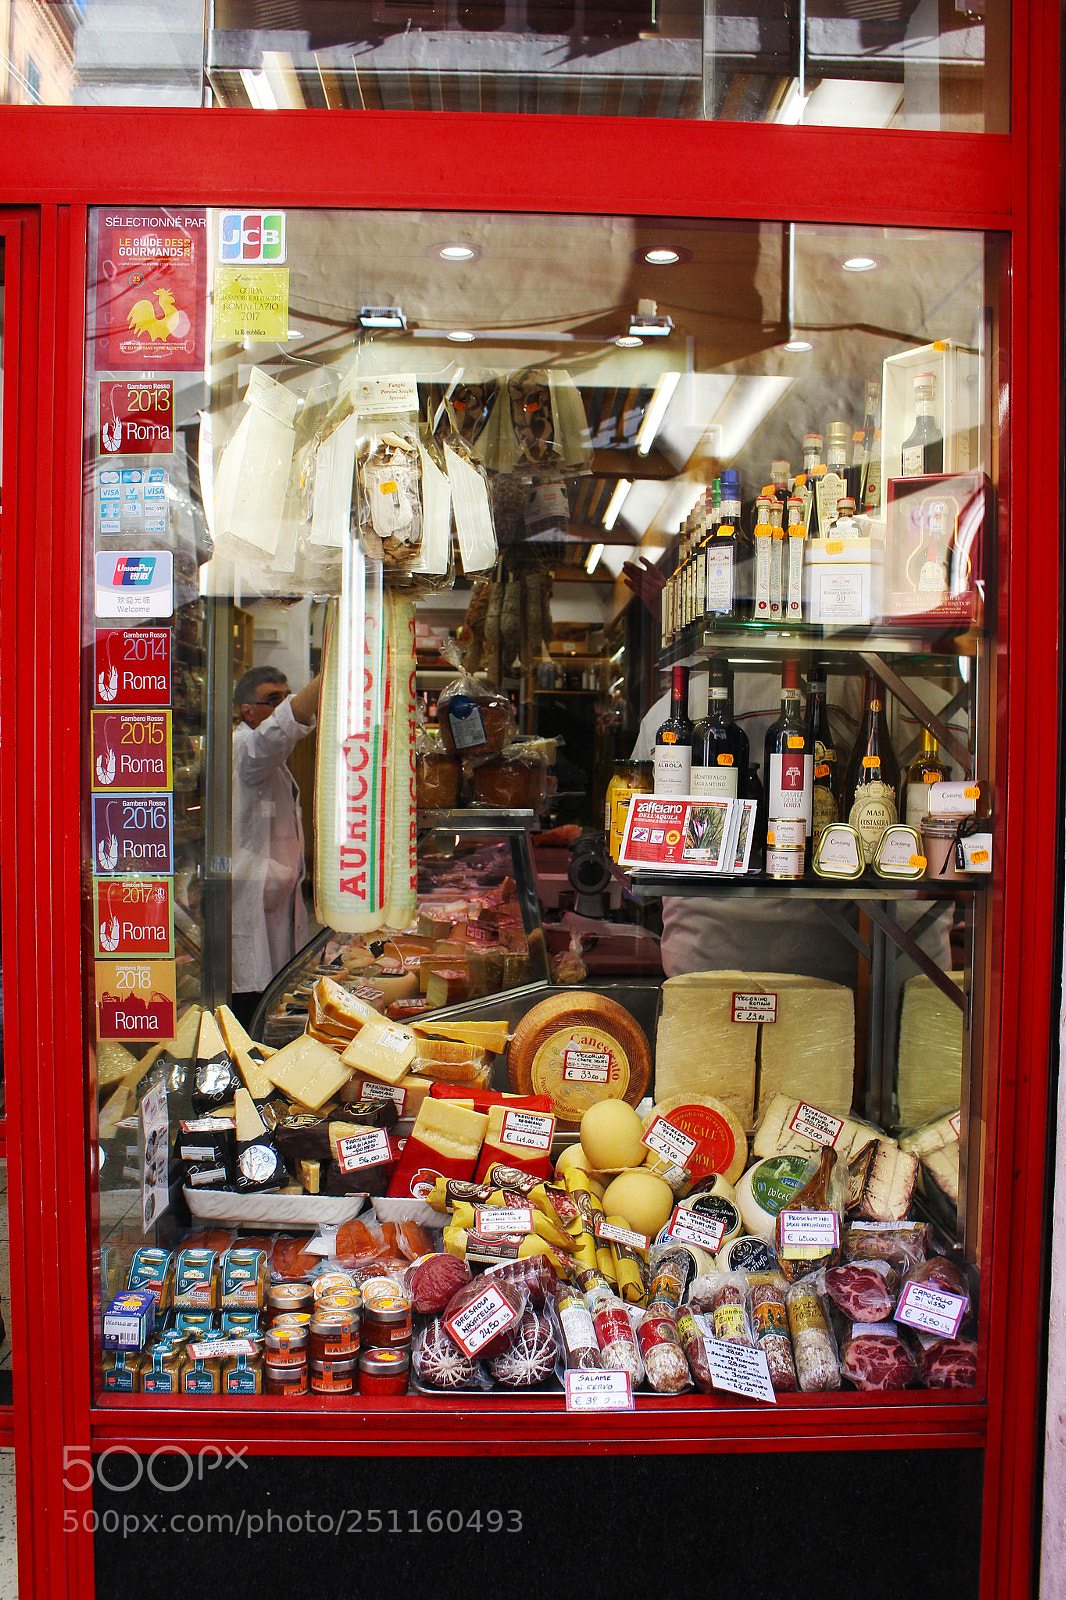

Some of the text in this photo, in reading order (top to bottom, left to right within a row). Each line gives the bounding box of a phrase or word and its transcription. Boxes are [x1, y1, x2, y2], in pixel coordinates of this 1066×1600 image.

[105, 215, 206, 228] SÉLECTIONNÉ PAR
[119, 238, 183, 247] LE GUIDE DES
[222, 228, 281, 245] JCB
[119, 247, 184, 257] GOURMANDS
[240, 287, 263, 295] GUIDA
[254, 303, 279, 311] LAZIO
[241, 312, 261, 321] 2017
[127, 390, 171, 412] 2013
[127, 422, 171, 440] Roma
[103, 487, 120, 496] VISA
[147, 486, 165, 495] VISA
[117, 564, 154, 574] UnionPay
[117, 605, 151, 613] Welcome
[123, 638, 168, 661] 2014
[123, 670, 167, 690] Roma
[120, 722, 164, 745] 2015
[120, 753, 165, 773] Roma
[636, 801, 683, 814] zafferano
[122, 806, 167, 829] 2016
[122, 839, 168, 859] Roma
[122, 887, 152, 903] 2017
[123, 921, 167, 941] Roma
[116, 971, 152, 990] 2018
[115, 1010, 159, 1031] Roma
[737, 1012, 743, 1020] €
[568, 1070, 574, 1078] €
[673, 1111, 704, 1124] ORMAGGIO
[802, 1105, 828, 1121] PECORINO
[680, 1119, 718, 1141] DUCALE
[795, 1122, 803, 1131] €
[506, 1132, 513, 1141] €
[347, 1158, 356, 1168] €
[675, 1228, 683, 1236] €
[787, 1233, 794, 1241] €
[912, 1287, 953, 1306] CAPOCOLLO
[454, 1296, 489, 1328] BRESAOLA
[904, 1308, 913, 1318] €
[468, 1337, 478, 1348] €
[577, 1374, 612, 1382] SALAME
[574, 1397, 582, 1406] €
